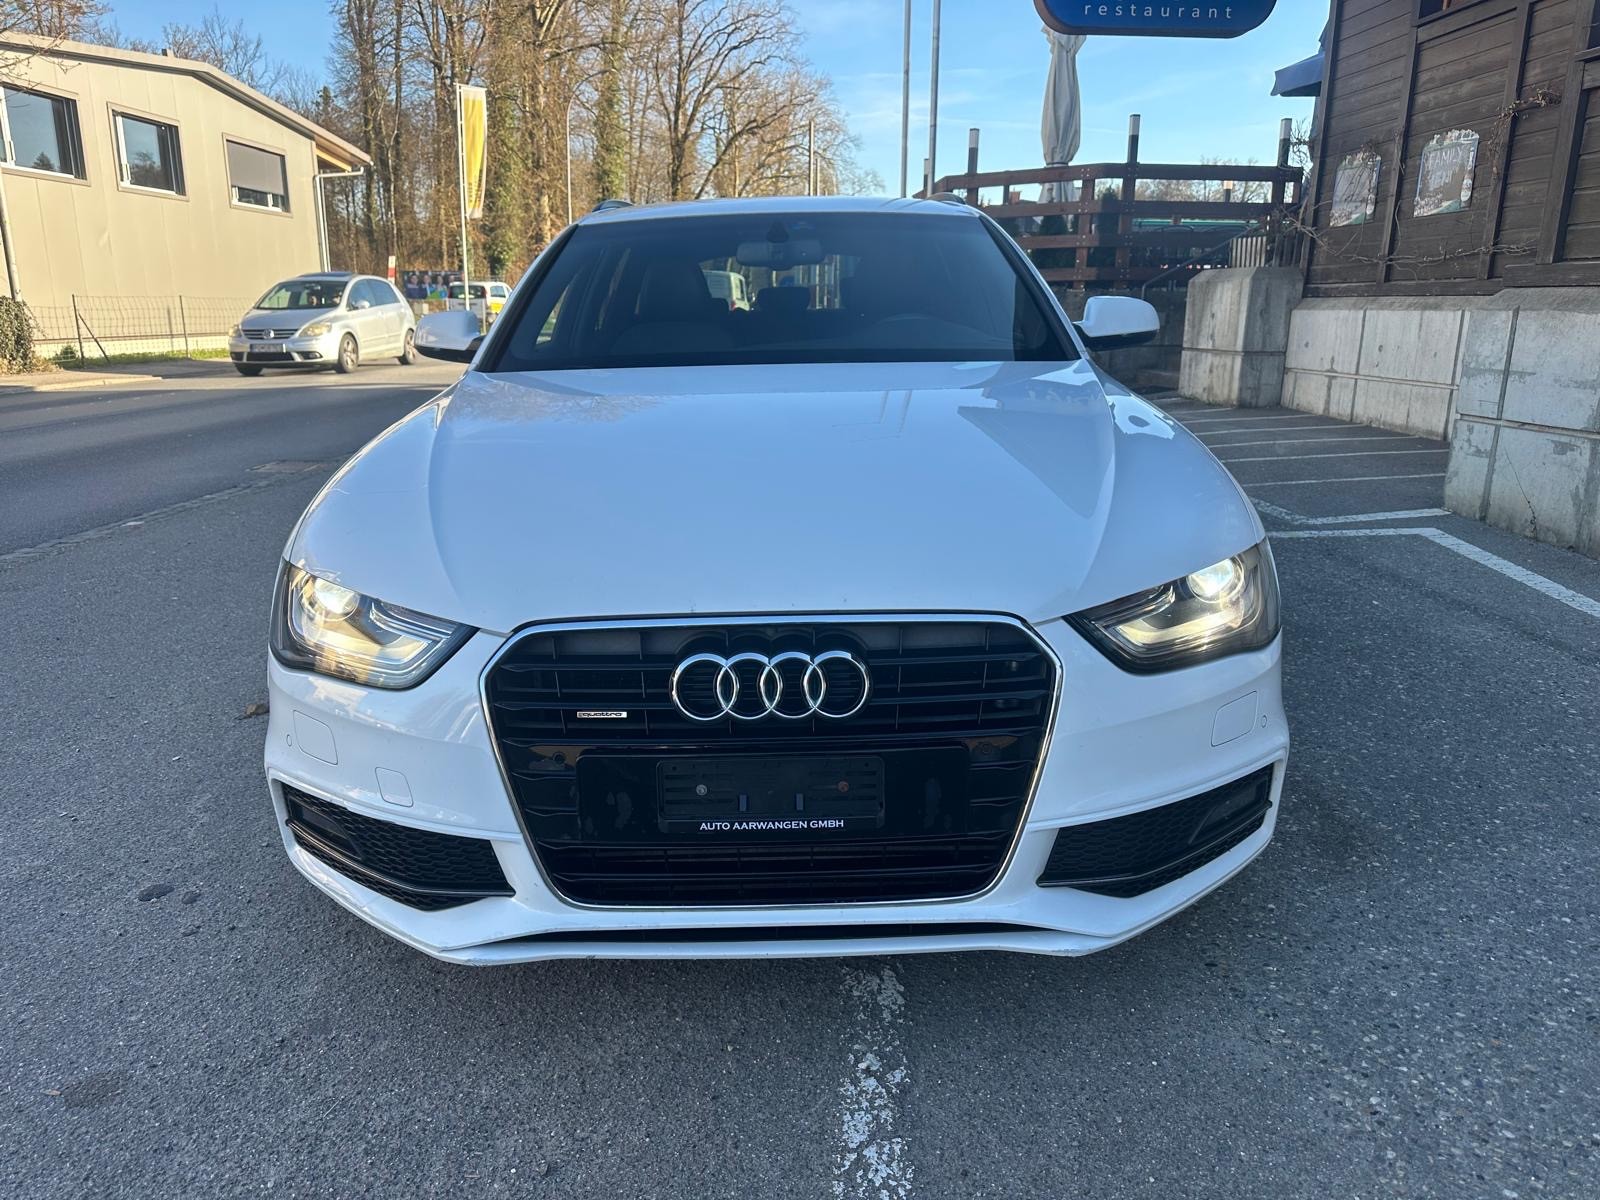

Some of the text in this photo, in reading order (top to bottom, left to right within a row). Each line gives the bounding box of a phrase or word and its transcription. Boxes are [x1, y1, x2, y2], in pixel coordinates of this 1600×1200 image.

[1084, 4, 1232, 19] restaurant
[699, 819, 845, 831] AUTO AARWANGEN GMBH
